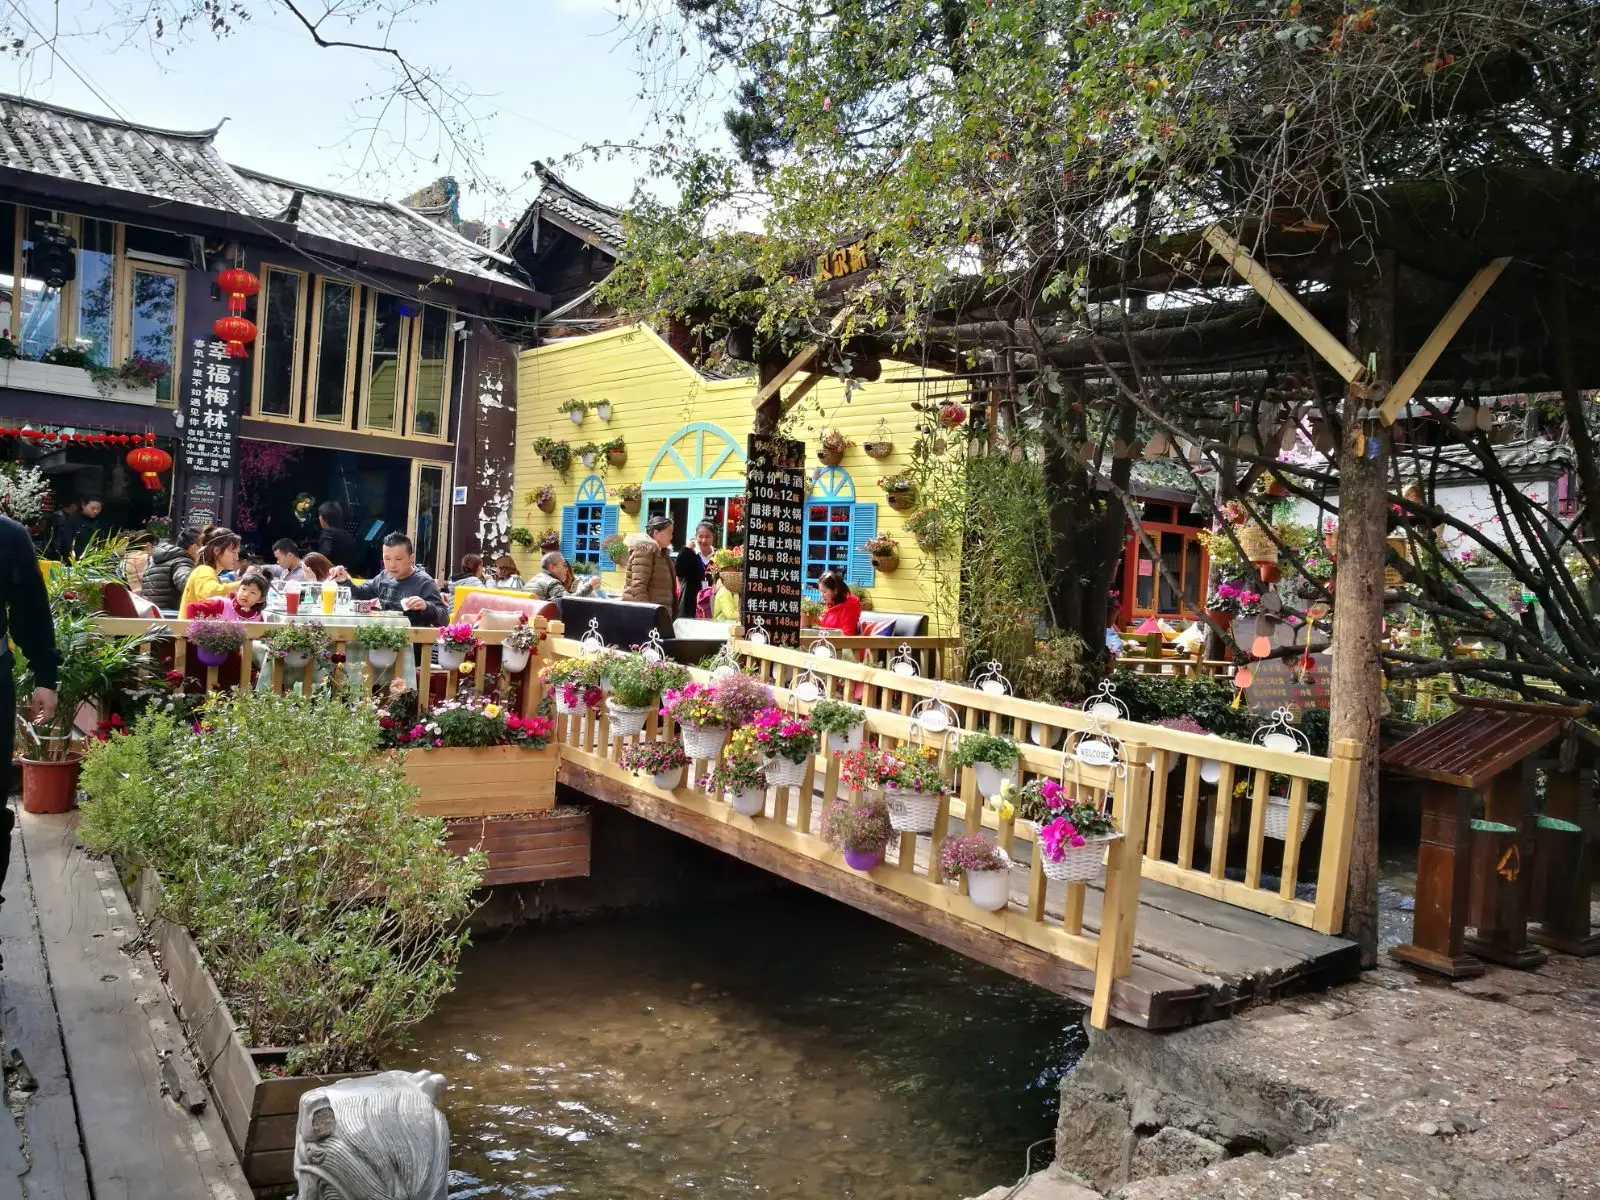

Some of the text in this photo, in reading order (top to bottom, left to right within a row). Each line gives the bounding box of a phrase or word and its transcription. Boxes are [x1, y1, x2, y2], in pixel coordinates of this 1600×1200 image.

[189, 339, 206, 427] 春风十里不如遇见你
[202, 340, 232, 430] 幸福梅林
[187, 428, 231, 440] 咖啡 下午茶
[187, 443, 231, 454] 中餐 火锅
[185, 456, 229, 468] 音乐 酒吧
[193, 464, 210, 472] Music
[753, 469, 803, 488] 特价啤酒
[751, 502, 802, 521] 腊排骨火锅
[749, 534, 801, 552] 野生菌土鸡锅
[748, 566, 800, 583] 黑山羊火锅
[747, 598, 799, 614] 牦牛肉火锅
[1079, 747, 1110, 760] WELCOME
